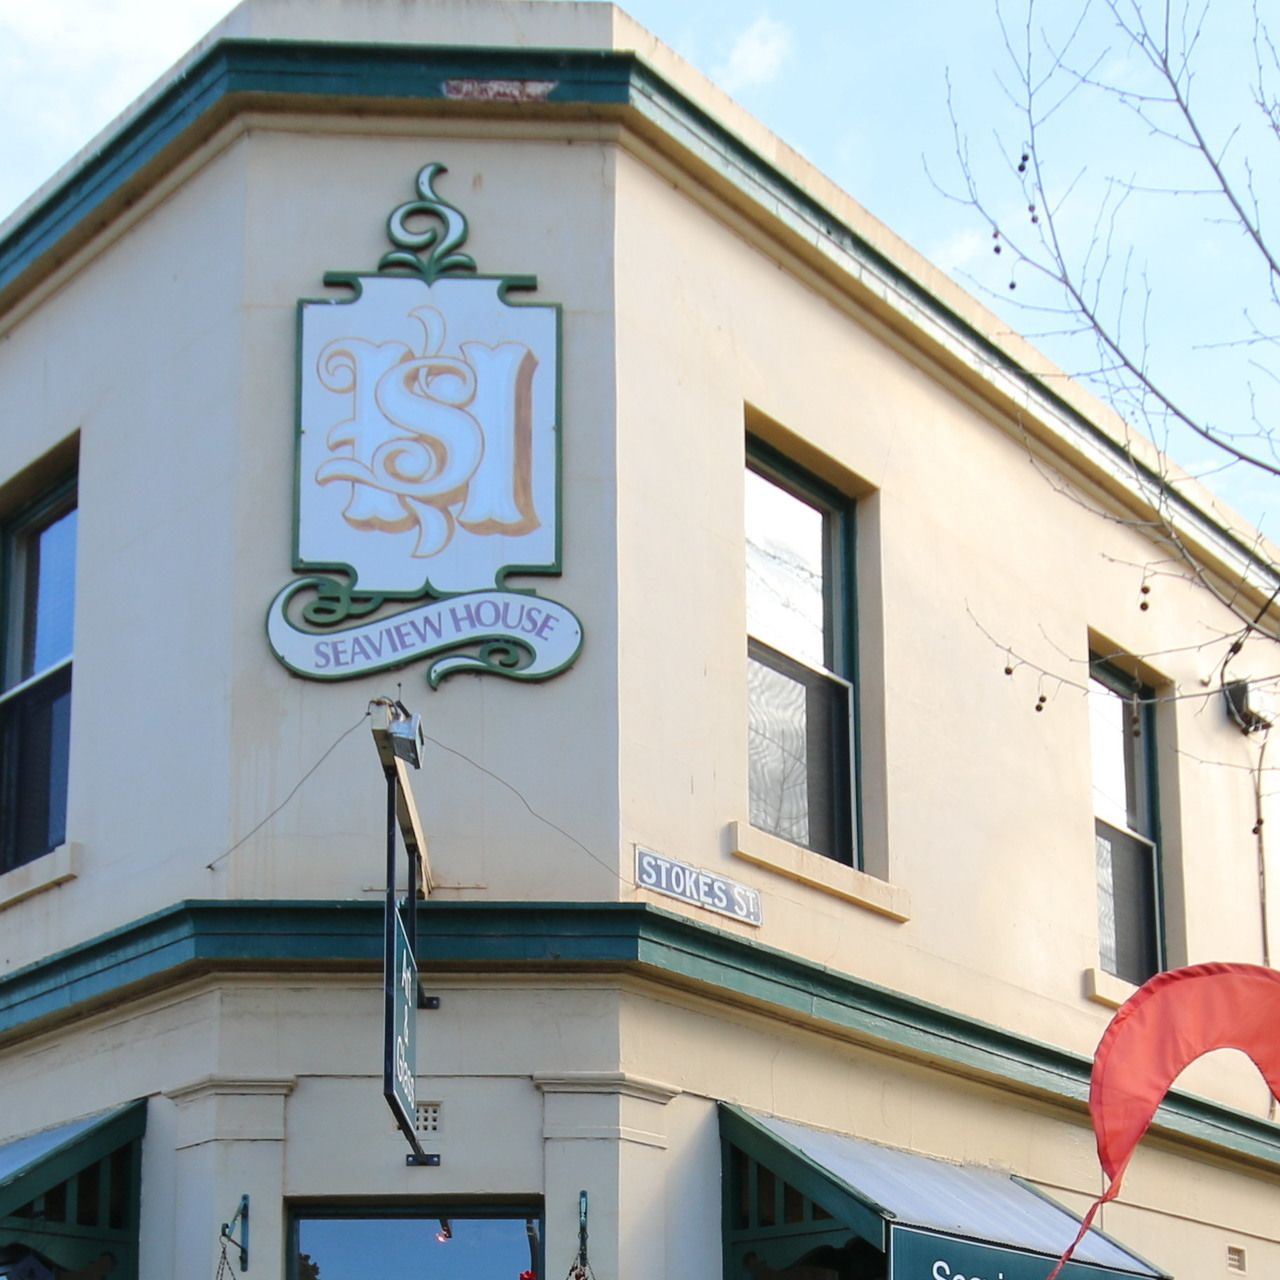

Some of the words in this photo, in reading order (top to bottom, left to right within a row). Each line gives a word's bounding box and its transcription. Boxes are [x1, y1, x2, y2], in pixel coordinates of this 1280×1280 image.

[314, 611, 442, 669] SEAVIEW
[449, 600, 559, 641] HOUSE
[642, 855, 728, 909] STOKES
